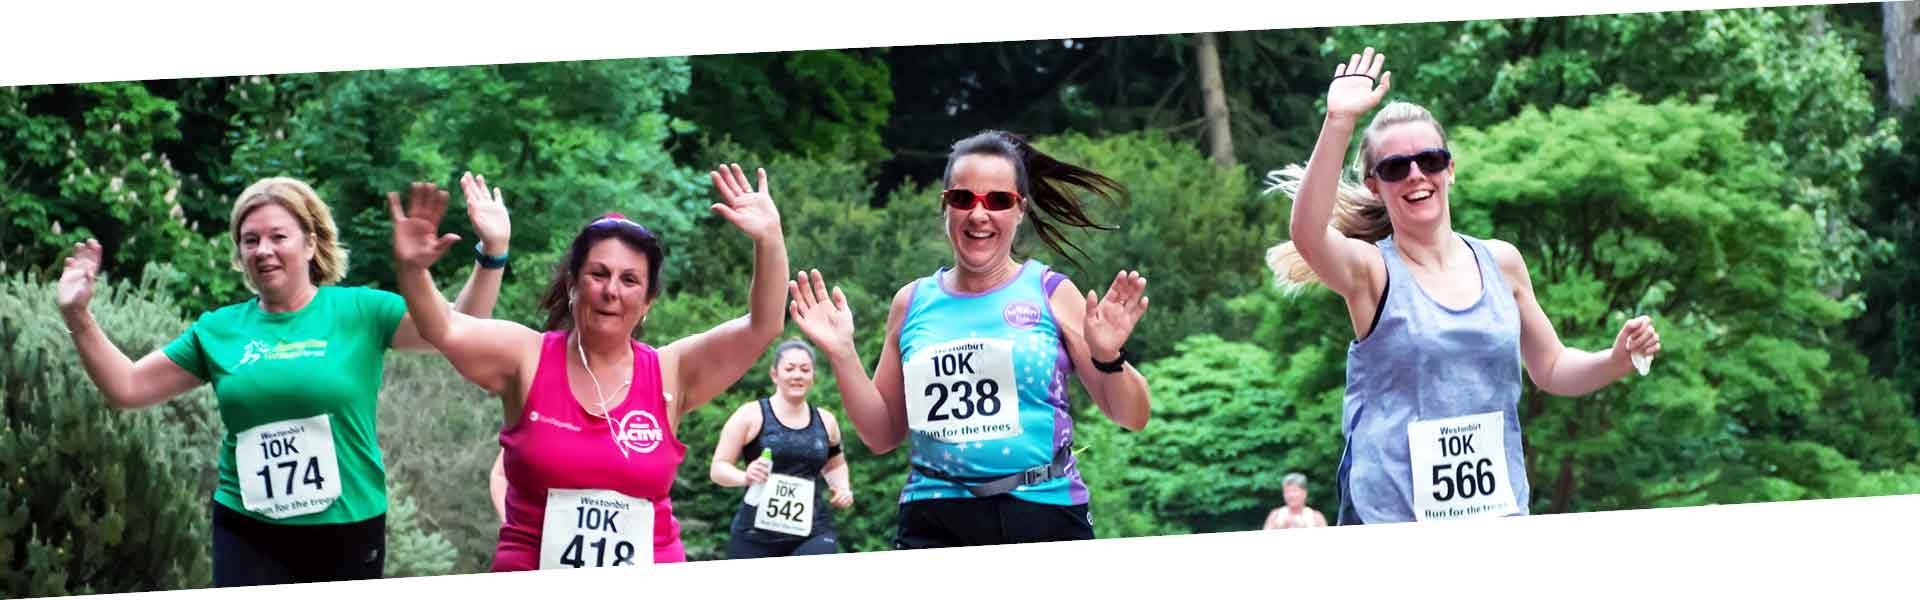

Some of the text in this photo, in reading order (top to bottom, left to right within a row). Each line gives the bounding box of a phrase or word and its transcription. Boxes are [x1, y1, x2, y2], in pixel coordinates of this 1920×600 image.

[931, 351, 975, 377] 10K
[924, 378, 1001, 422] 238
[617, 428, 663, 441] ACTIVE
[943, 427, 958, 437] for
[961, 424, 980, 436] the
[982, 423, 1011, 433] trees
[1440, 424, 1481, 435] Westonbirt
[260, 436, 299, 460] 10K
[1438, 433, 1475, 457] 10K
[257, 456, 325, 499] 174
[1432, 458, 1496, 502] 566
[580, 496, 630, 511] Westonbirt
[776, 485, 797, 498] 10K
[274, 503, 290, 513] for
[291, 500, 309, 509] the
[766, 497, 805, 522] 542
[1449, 507, 1464, 516] for
[1466, 505, 1481, 514] the
[576, 506, 620, 533] 10K
[559, 534, 636, 569] 418
